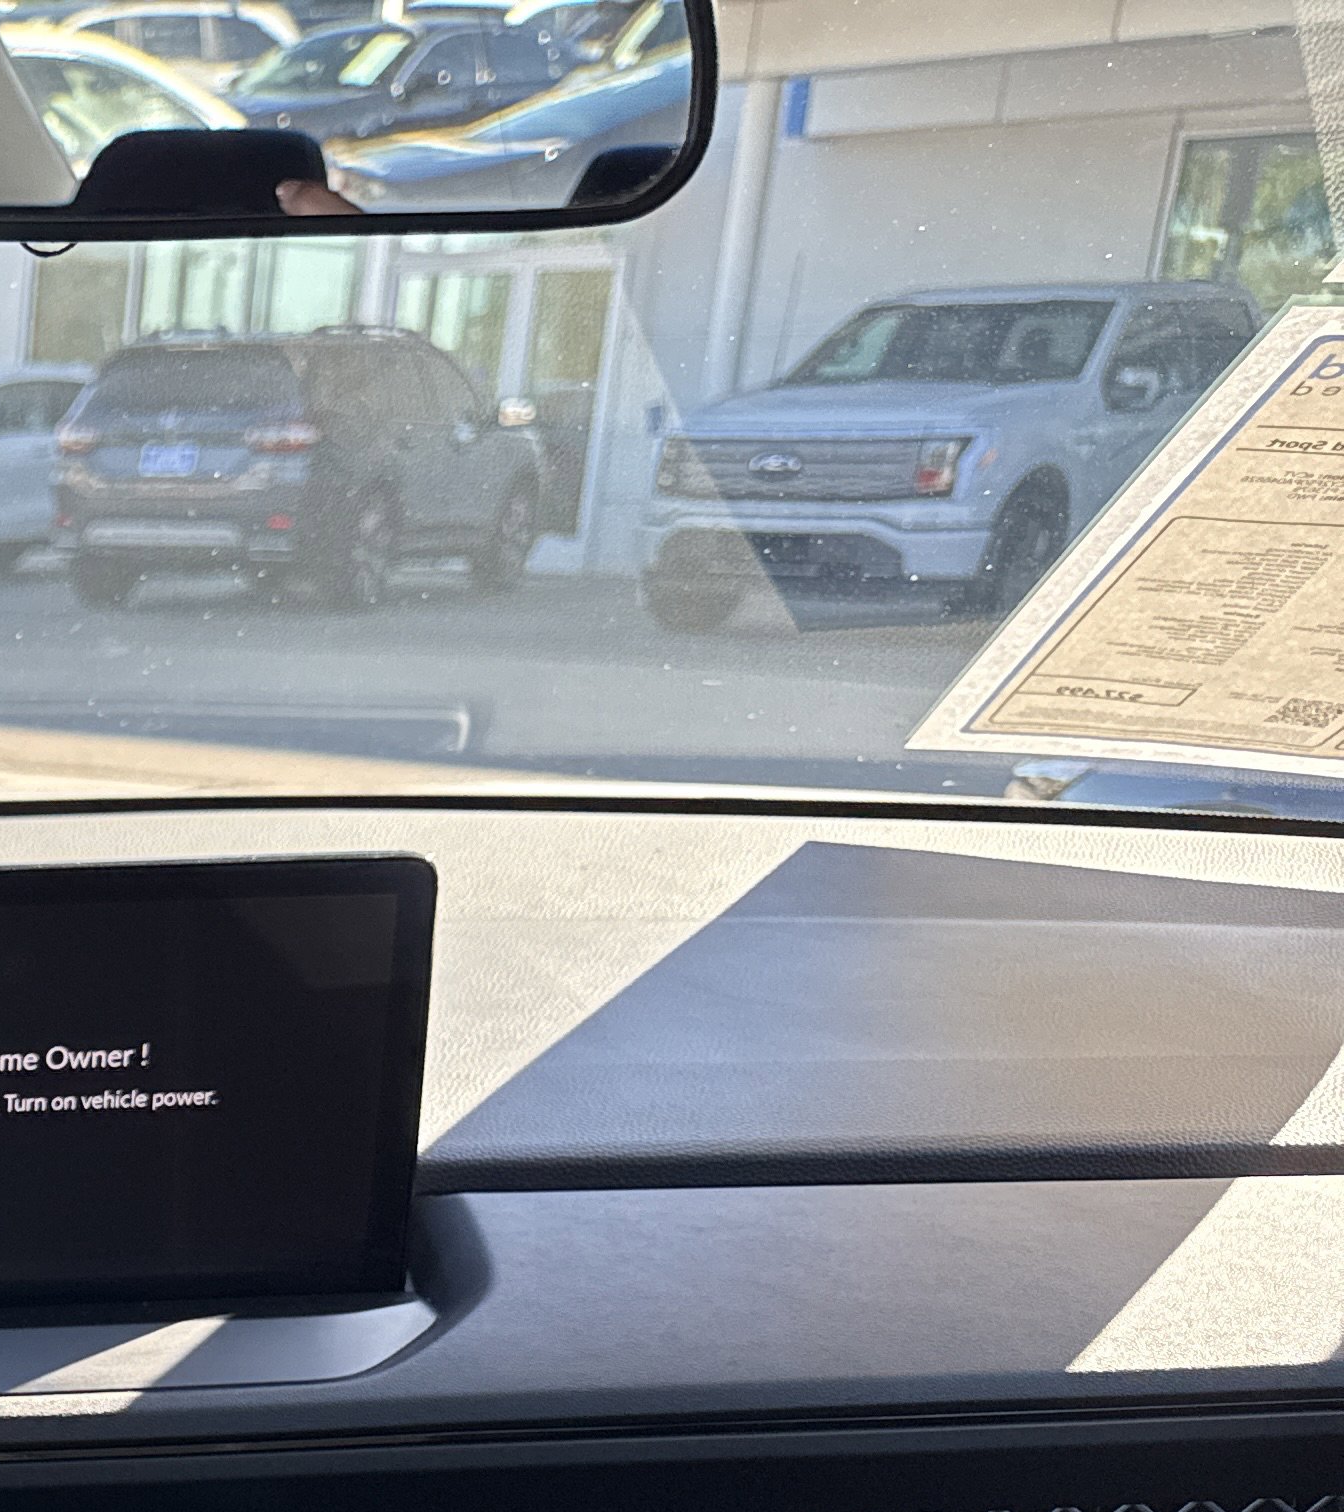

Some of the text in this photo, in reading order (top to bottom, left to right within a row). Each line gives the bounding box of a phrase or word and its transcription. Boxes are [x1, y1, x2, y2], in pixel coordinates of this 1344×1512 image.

[45, 1045, 135, 1070] Owner
[140, 1042, 152, 1067] !
[3, 1093, 48, 1113] Turn
[51, 1096, 77, 1112] on
[80, 1089, 148, 1110] vehicle
[151, 1090, 218, 1111] power.
